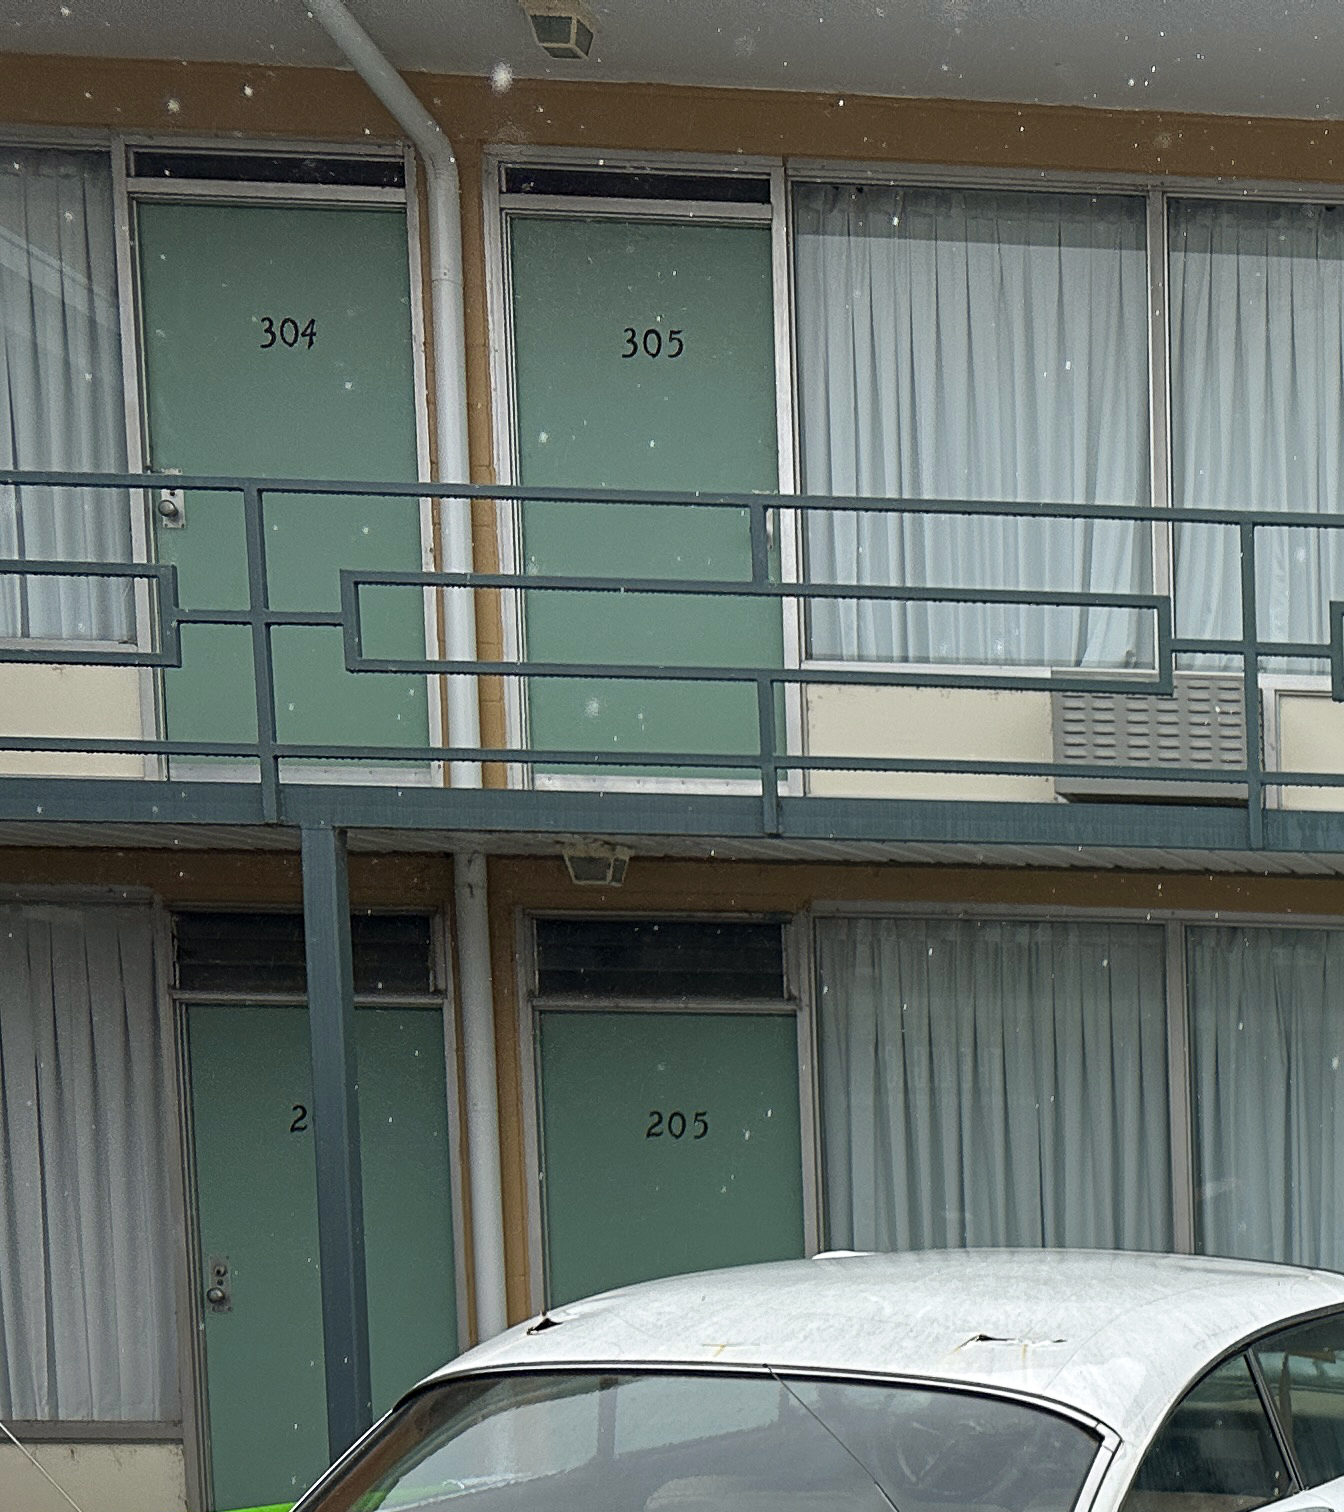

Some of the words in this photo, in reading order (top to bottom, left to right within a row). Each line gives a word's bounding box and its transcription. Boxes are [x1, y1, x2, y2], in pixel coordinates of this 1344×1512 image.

[260, 317, 316, 349] 304
[622, 328, 683, 358] 305
[647, 1111, 708, 1139] 205
